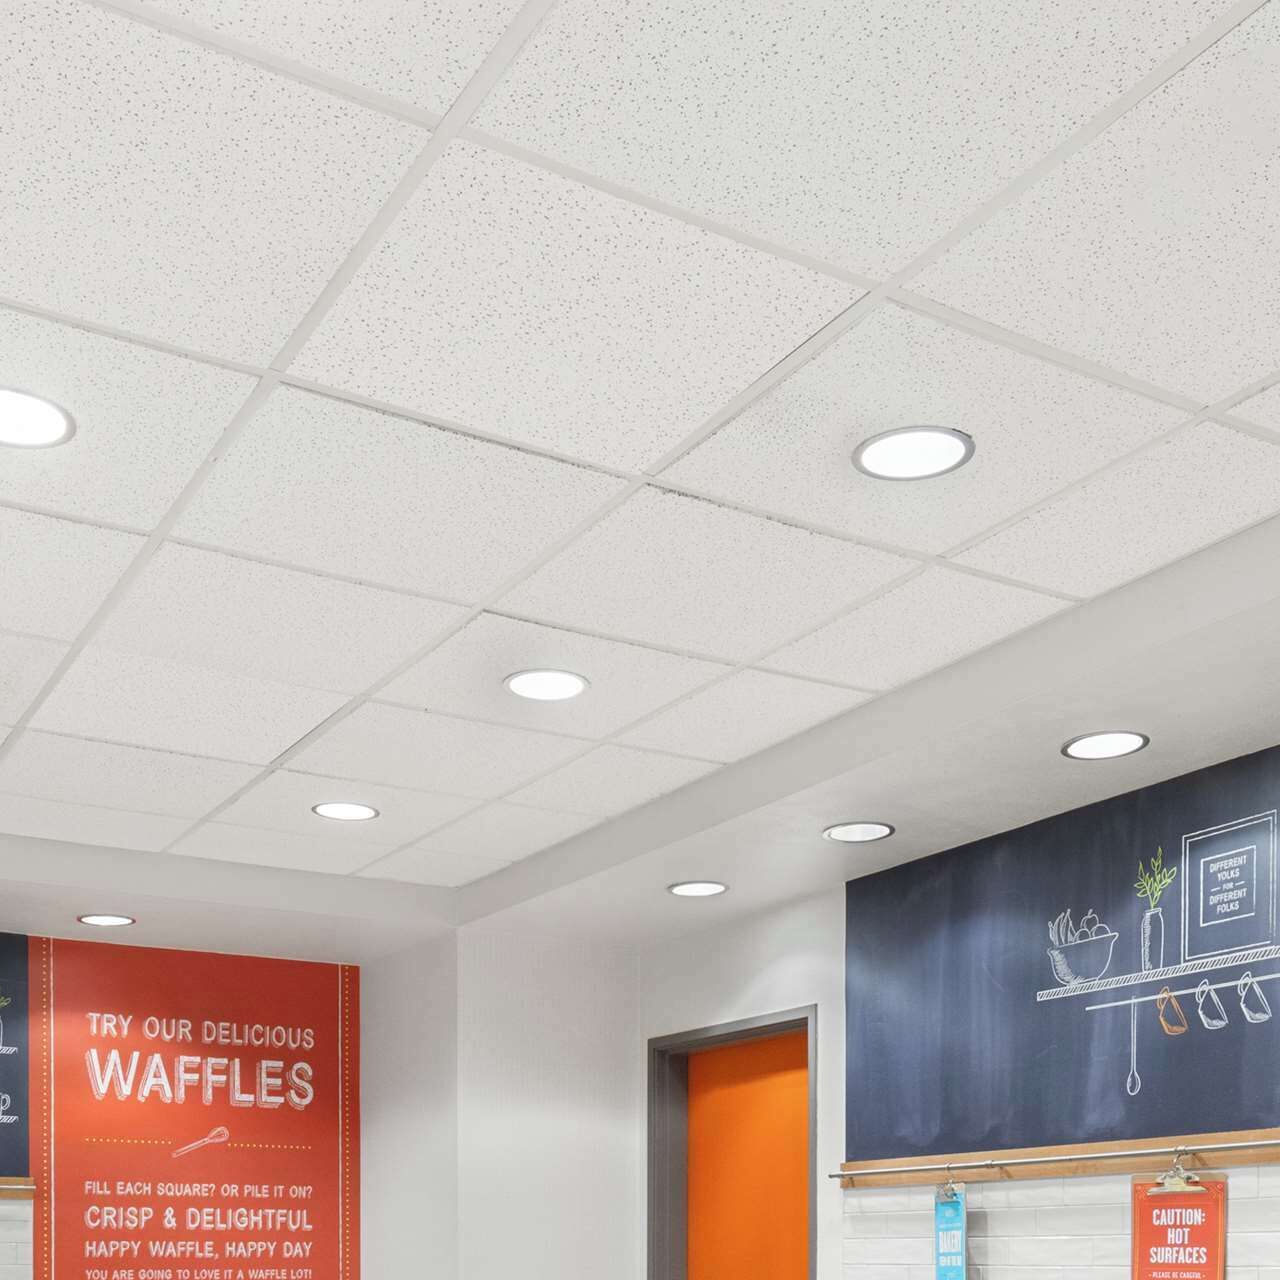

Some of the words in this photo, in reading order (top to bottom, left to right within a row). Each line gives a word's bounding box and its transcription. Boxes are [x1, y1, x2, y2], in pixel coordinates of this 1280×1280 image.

[1209, 855, 1247, 873] DIFFERENT
[1217, 868, 1240, 881] YOLKS
[1209, 888, 1248, 905] DIFFERENT
[1216, 901, 1240, 914] FOLKS
[86, 1012, 133, 1039] TRY
[144, 1016, 193, 1042] OUR
[201, 1020, 315, 1050] DELICIOUS
[85, 1048, 315, 1110] WAFFLES
[84, 1181, 111, 1195] FILL
[116, 1182, 152, 1195] EACH
[156, 1183, 216, 1198] SQUARE?
[221, 1184, 239, 1197] OR
[244, 1185, 269, 1198] PILE
[274, 1185, 284, 1198] IT
[289, 1185, 313, 1199] ON?
[84, 1206, 153, 1229] CRISP
[164, 1206, 177, 1229] &
[186, 1206, 313, 1231] DELIGHTFUL
[1152, 1208, 1206, 1226] CAUTION:
[1167, 1228, 1190, 1245] HOT
[84, 1240, 141, 1258] HAPPY
[149, 1241, 219, 1260] WAFFLE,
[225, 1242, 276, 1259] HAPPY
[283, 1242, 313, 1259] DAY
[1149, 1246, 1207, 1264] SURFACES
[86, 1269, 110, 1280] YOU
[112, 1269, 134, 1280] ARE
[138, 1269, 172, 1280] GOING
[176, 1269, 190, 1280] TO
[194, 1269, 221, 1280] LOVE
[223, 1269, 234, 1280] IT
[236, 1269, 244, 1280] A
[248, 1269, 287, 1280] WAFFLE
[290, 1268, 313, 1280] LOT!
[1152, 1271, 1171, 1279] PLEASE
[1172, 1271, 1179, 1279] BE
[1179, 1271, 1201, 1279] CAREFUL
